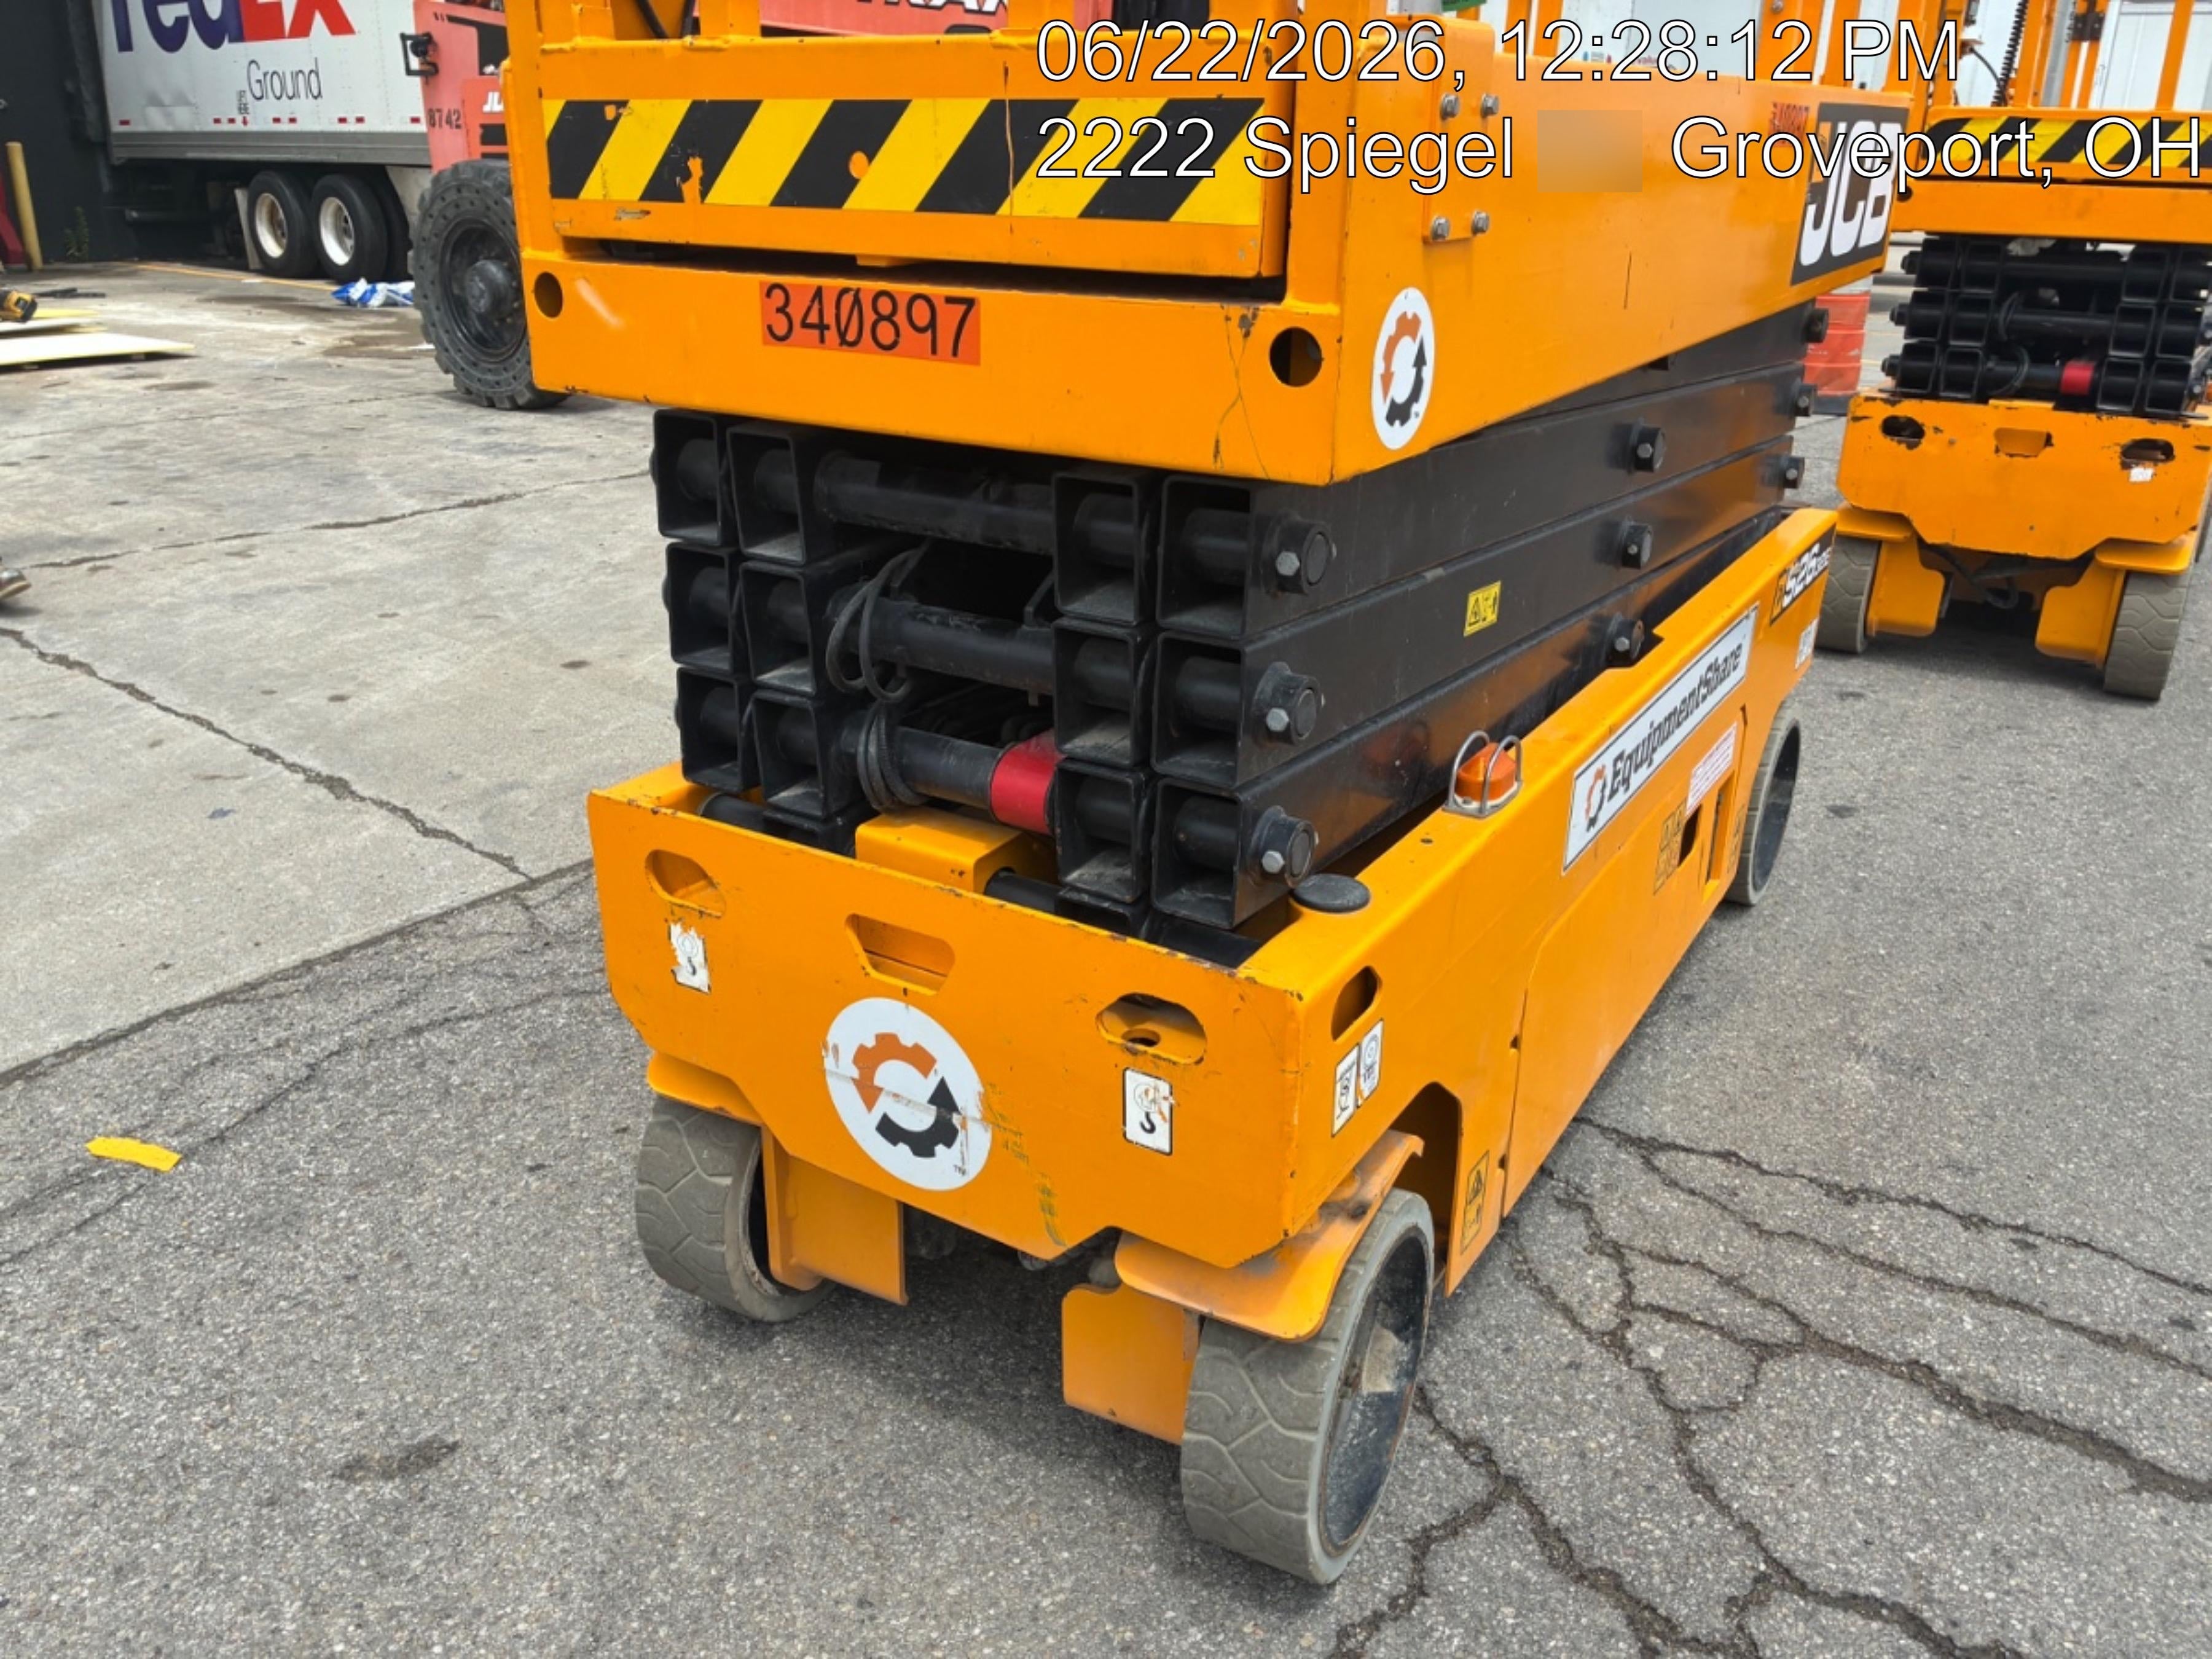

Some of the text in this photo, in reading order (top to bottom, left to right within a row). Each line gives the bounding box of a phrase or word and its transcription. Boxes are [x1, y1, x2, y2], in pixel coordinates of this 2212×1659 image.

[247, 57, 323, 101] Ground
[1800, 120, 1903, 266] JCB
[765, 282, 976, 357] 340897
[1607, 643, 1743, 801] EquipmentShare
